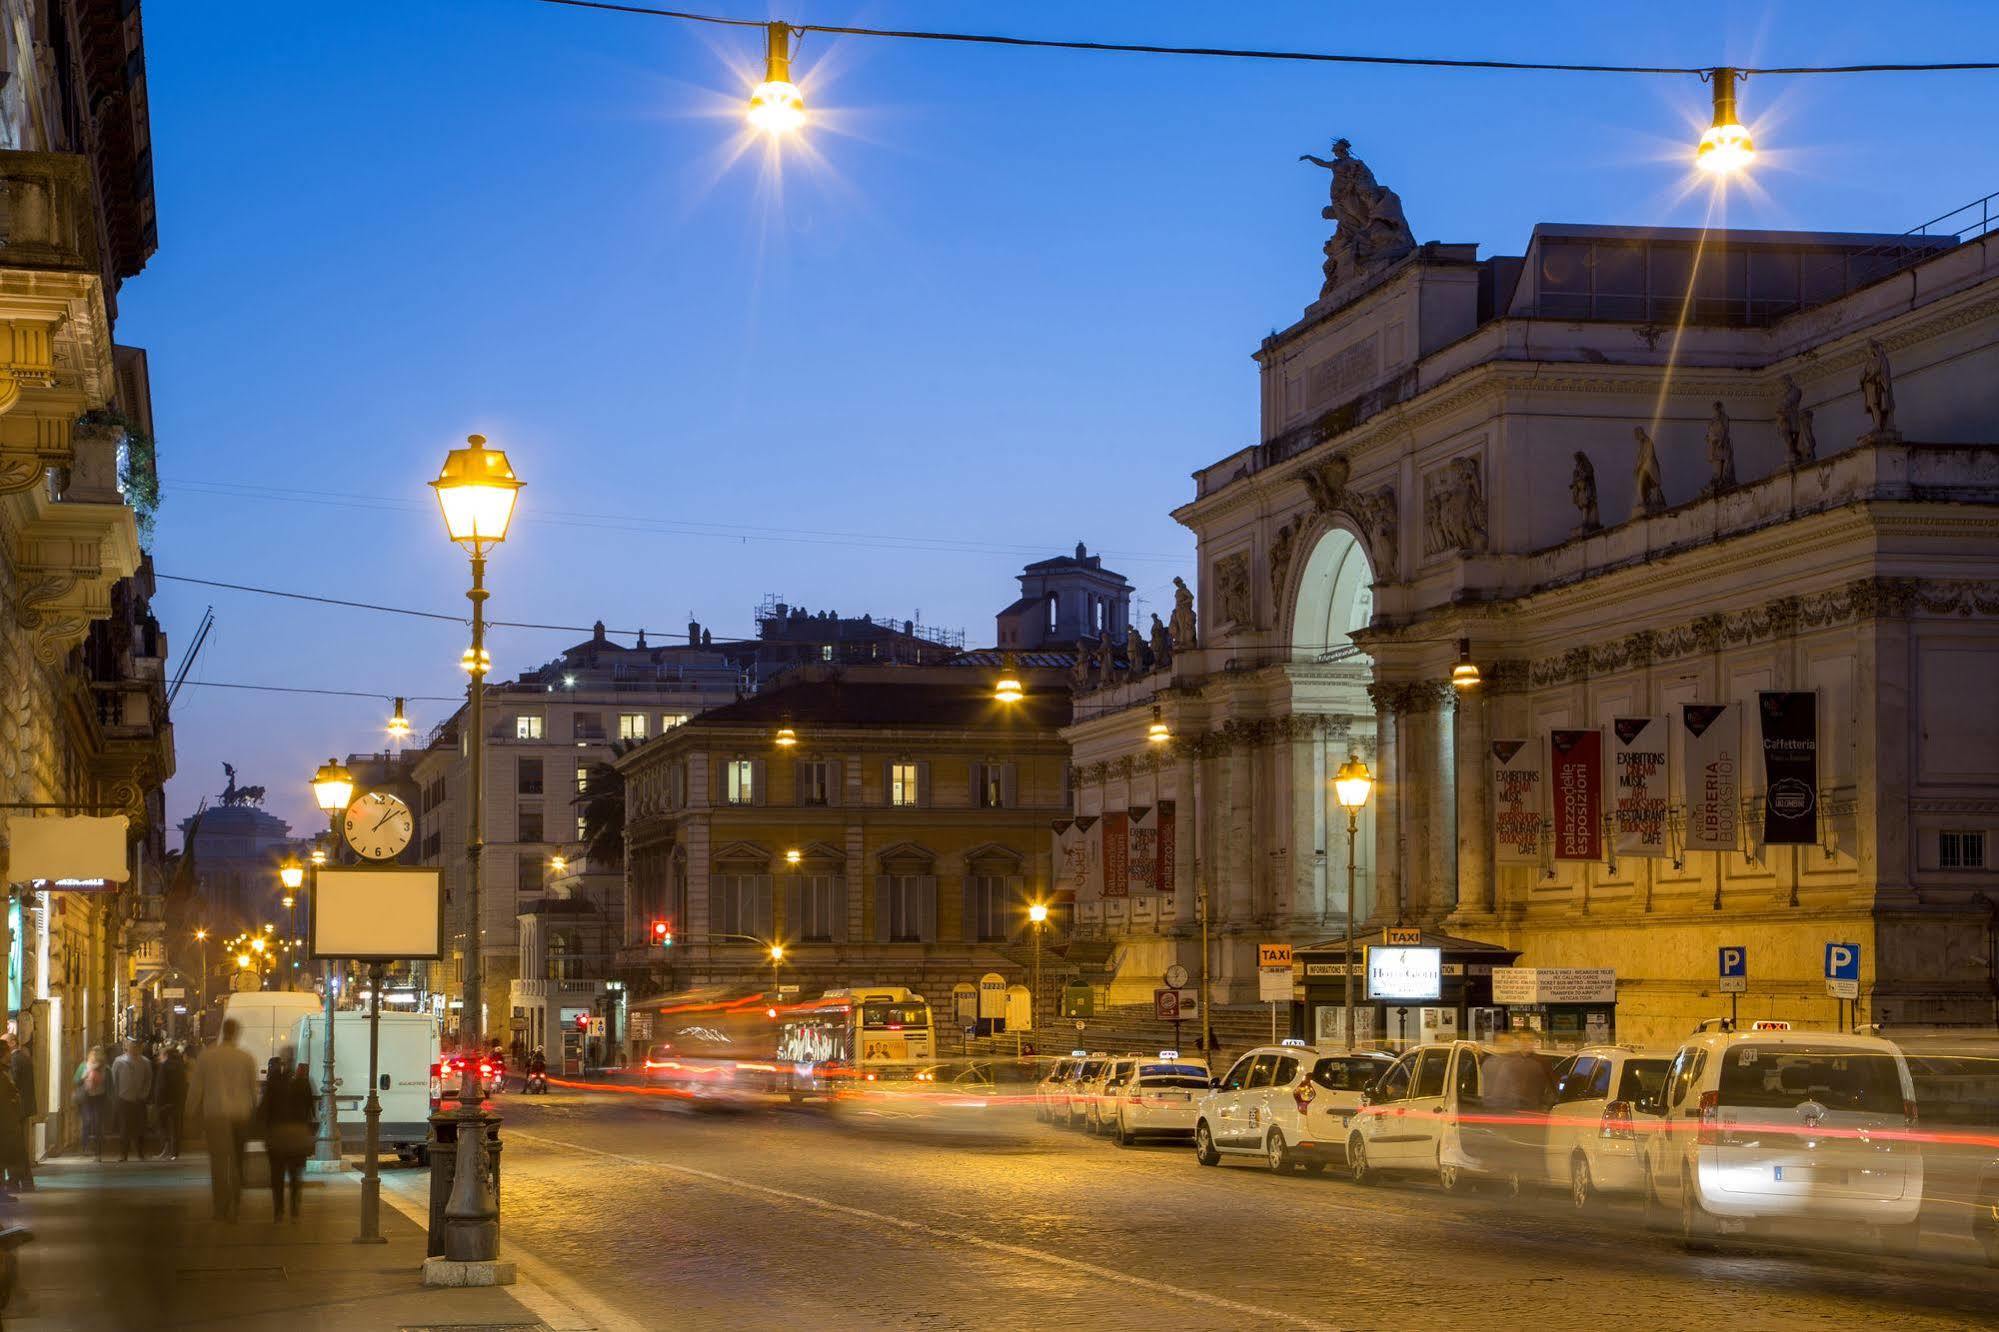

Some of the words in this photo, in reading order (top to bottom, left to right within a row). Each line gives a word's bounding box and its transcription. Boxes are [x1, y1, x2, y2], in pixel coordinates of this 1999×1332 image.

[1763, 738, 1816, 751] Caffetteria
[1616, 752, 1665, 765] EXHIBITIONS
[1705, 762, 1718, 842] LIBRERIA
[1719, 751, 1733, 842] BOOKSHOP
[1576, 763, 1591, 855] esposizioni
[1616, 809, 1665, 821] RESTAURANT
[346, 821, 353, 831] 9
[404, 822, 410, 832] 3
[375, 847, 381, 857] 6
[1391, 933, 1419, 942] TAXI
[1262, 950, 1290, 960] TAXI
[1831, 946, 1852, 976] P
[1724, 949, 1740, 974] P
[1760, 1022, 1787, 1031] TAXI
